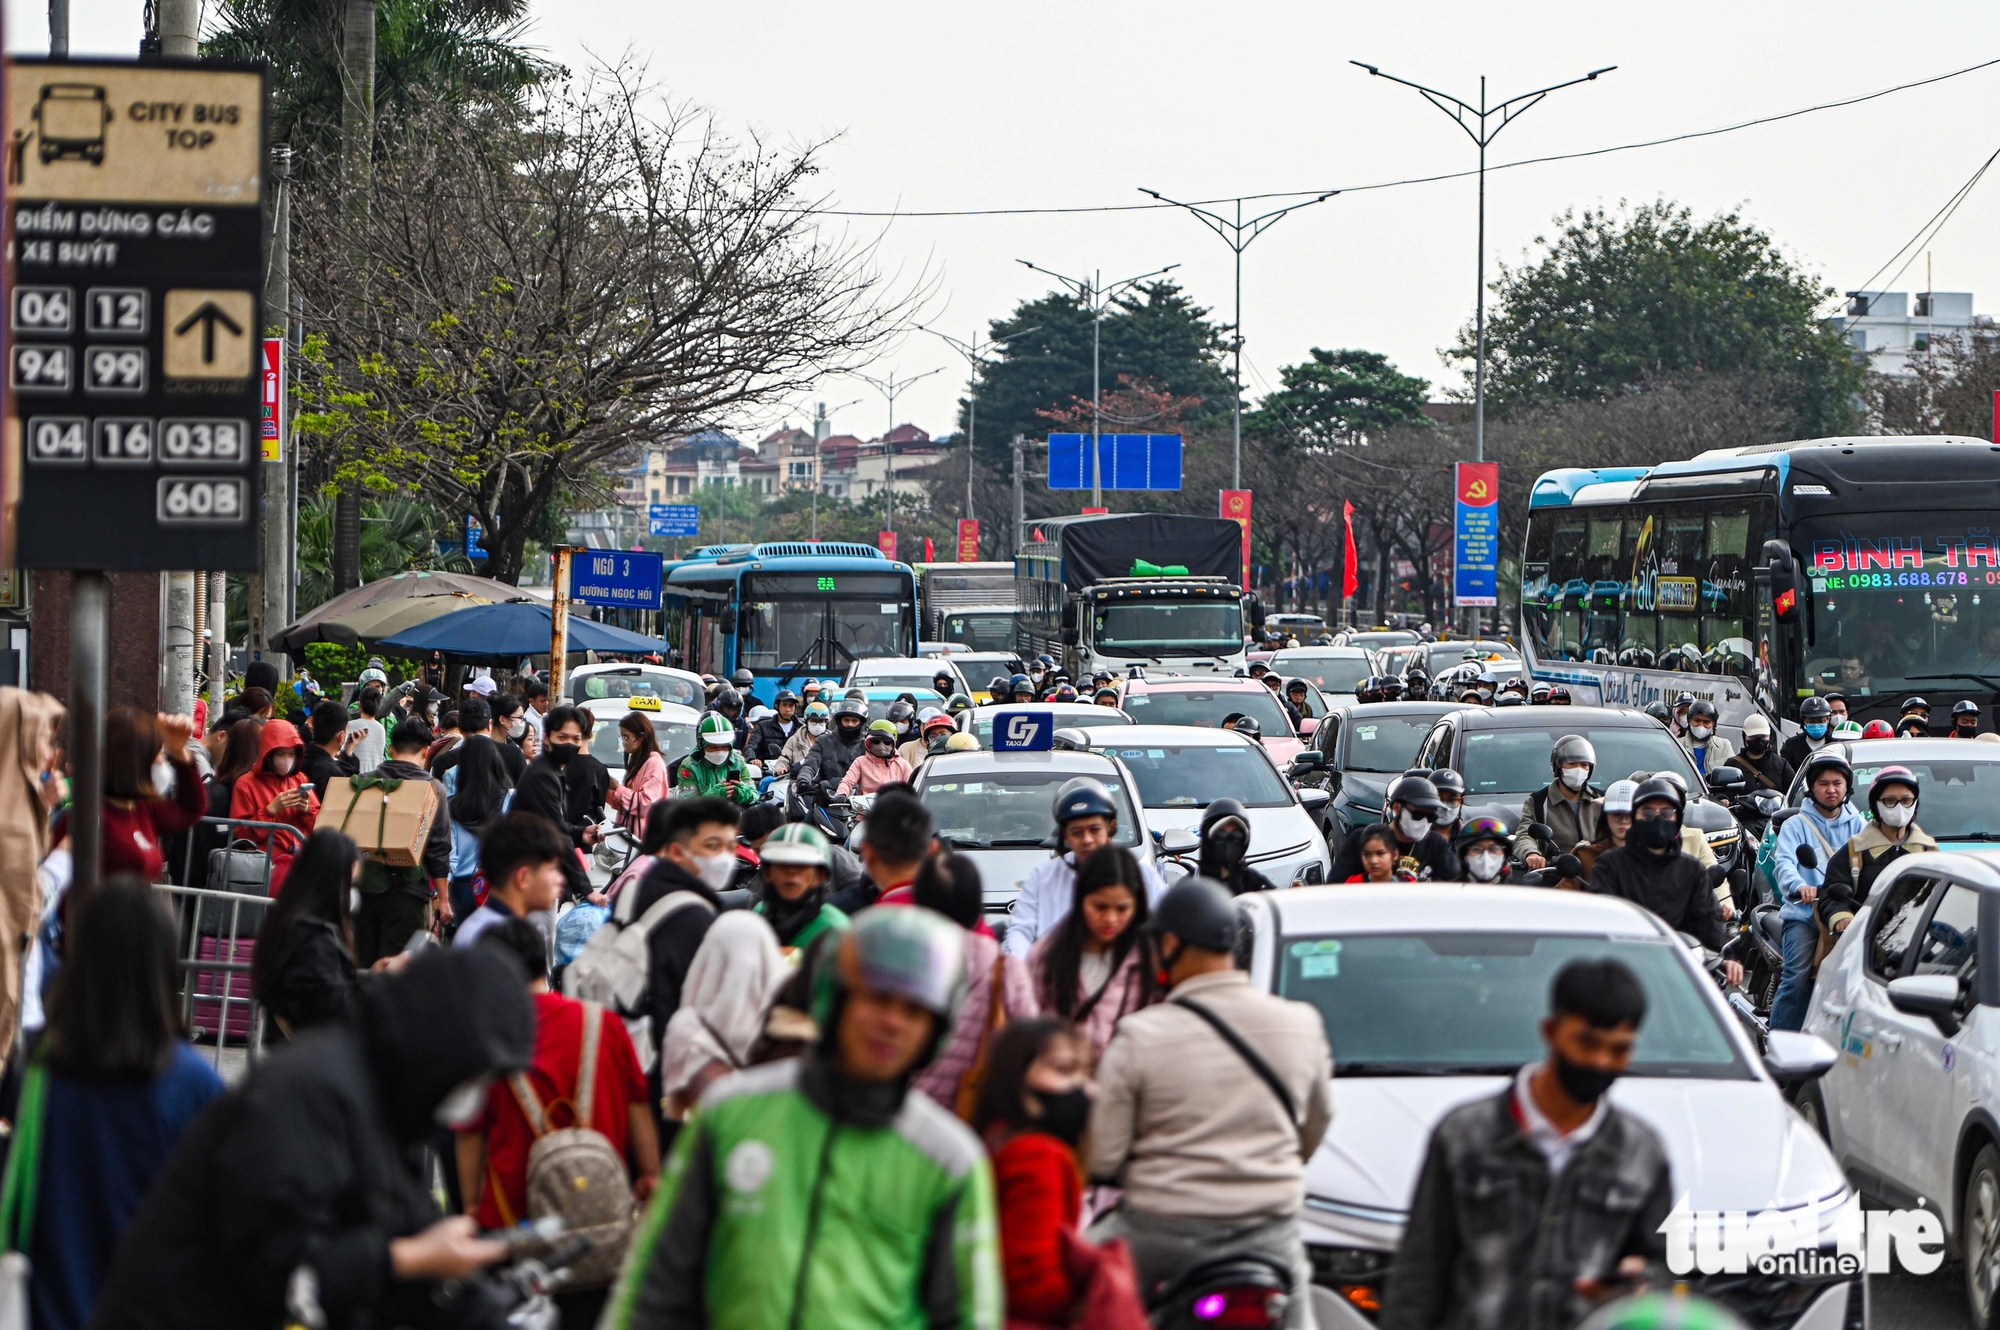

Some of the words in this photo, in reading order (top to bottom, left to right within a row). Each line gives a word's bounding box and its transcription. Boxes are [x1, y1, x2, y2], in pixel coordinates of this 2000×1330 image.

[128, 101, 184, 122] CITY
[192, 103, 240, 125] BUS
[165, 129, 216, 150] TOP
[80, 208, 150, 233] DỪNG
[156, 208, 213, 234] CÁC
[22, 241, 52, 262] XE
[58, 238, 118, 265] BUÝT
[20, 292, 67, 324] 06
[97, 295, 140, 326] 12
[18, 350, 65, 382] 94
[93, 352, 140, 383] 99
[36, 423, 83, 454] 04
[104, 423, 148, 455] 16
[165, 423, 238, 455] 03B
[165, 483, 238, 514] 60B
[1813, 530, 1924, 572] BÌNH
[1936, 526, 2000, 568] TĂ
[592, 554, 614, 576] NGÕ
[622, 558, 630, 577] 3
[579, 584, 609, 598] ĐƯỜNG
[611, 587, 635, 602] NGỌC
[1825, 577, 1845, 589] NE:
[1849, 571, 1968, 588] 0983.688.678
[1007, 715, 1039, 747] G7
